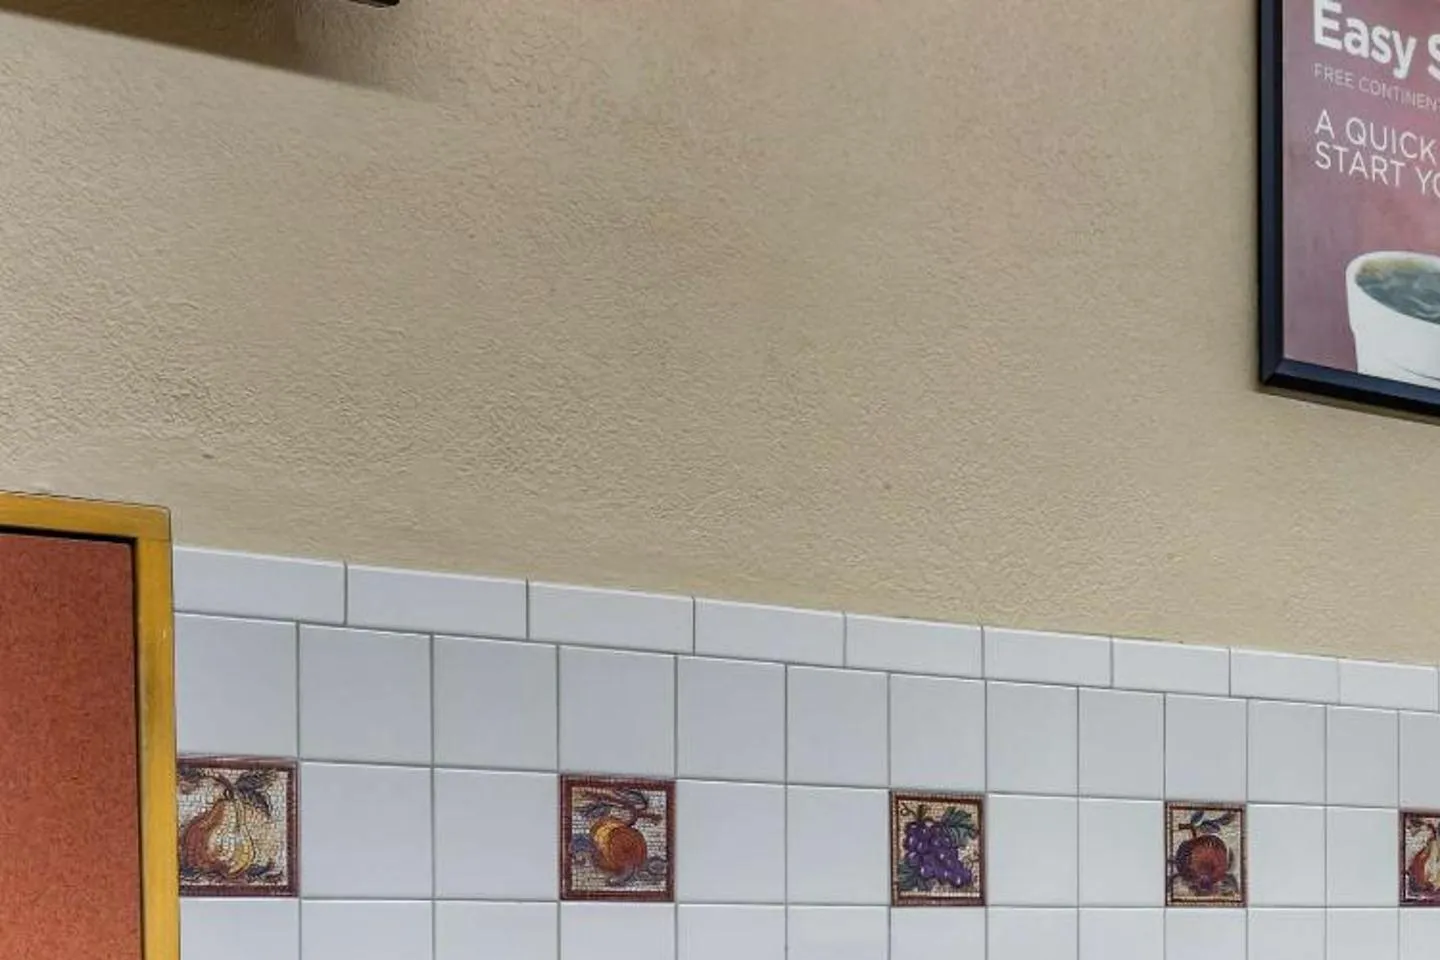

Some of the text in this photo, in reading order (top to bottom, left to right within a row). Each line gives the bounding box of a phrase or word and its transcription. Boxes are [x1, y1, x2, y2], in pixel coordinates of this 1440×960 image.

[1313, 0, 1417, 79] Easy
[1314, 62, 1355, 89] FREE
[1314, 109, 1335, 140] A
[1345, 117, 1437, 167] QUICK
[1315, 140, 1406, 188] START
